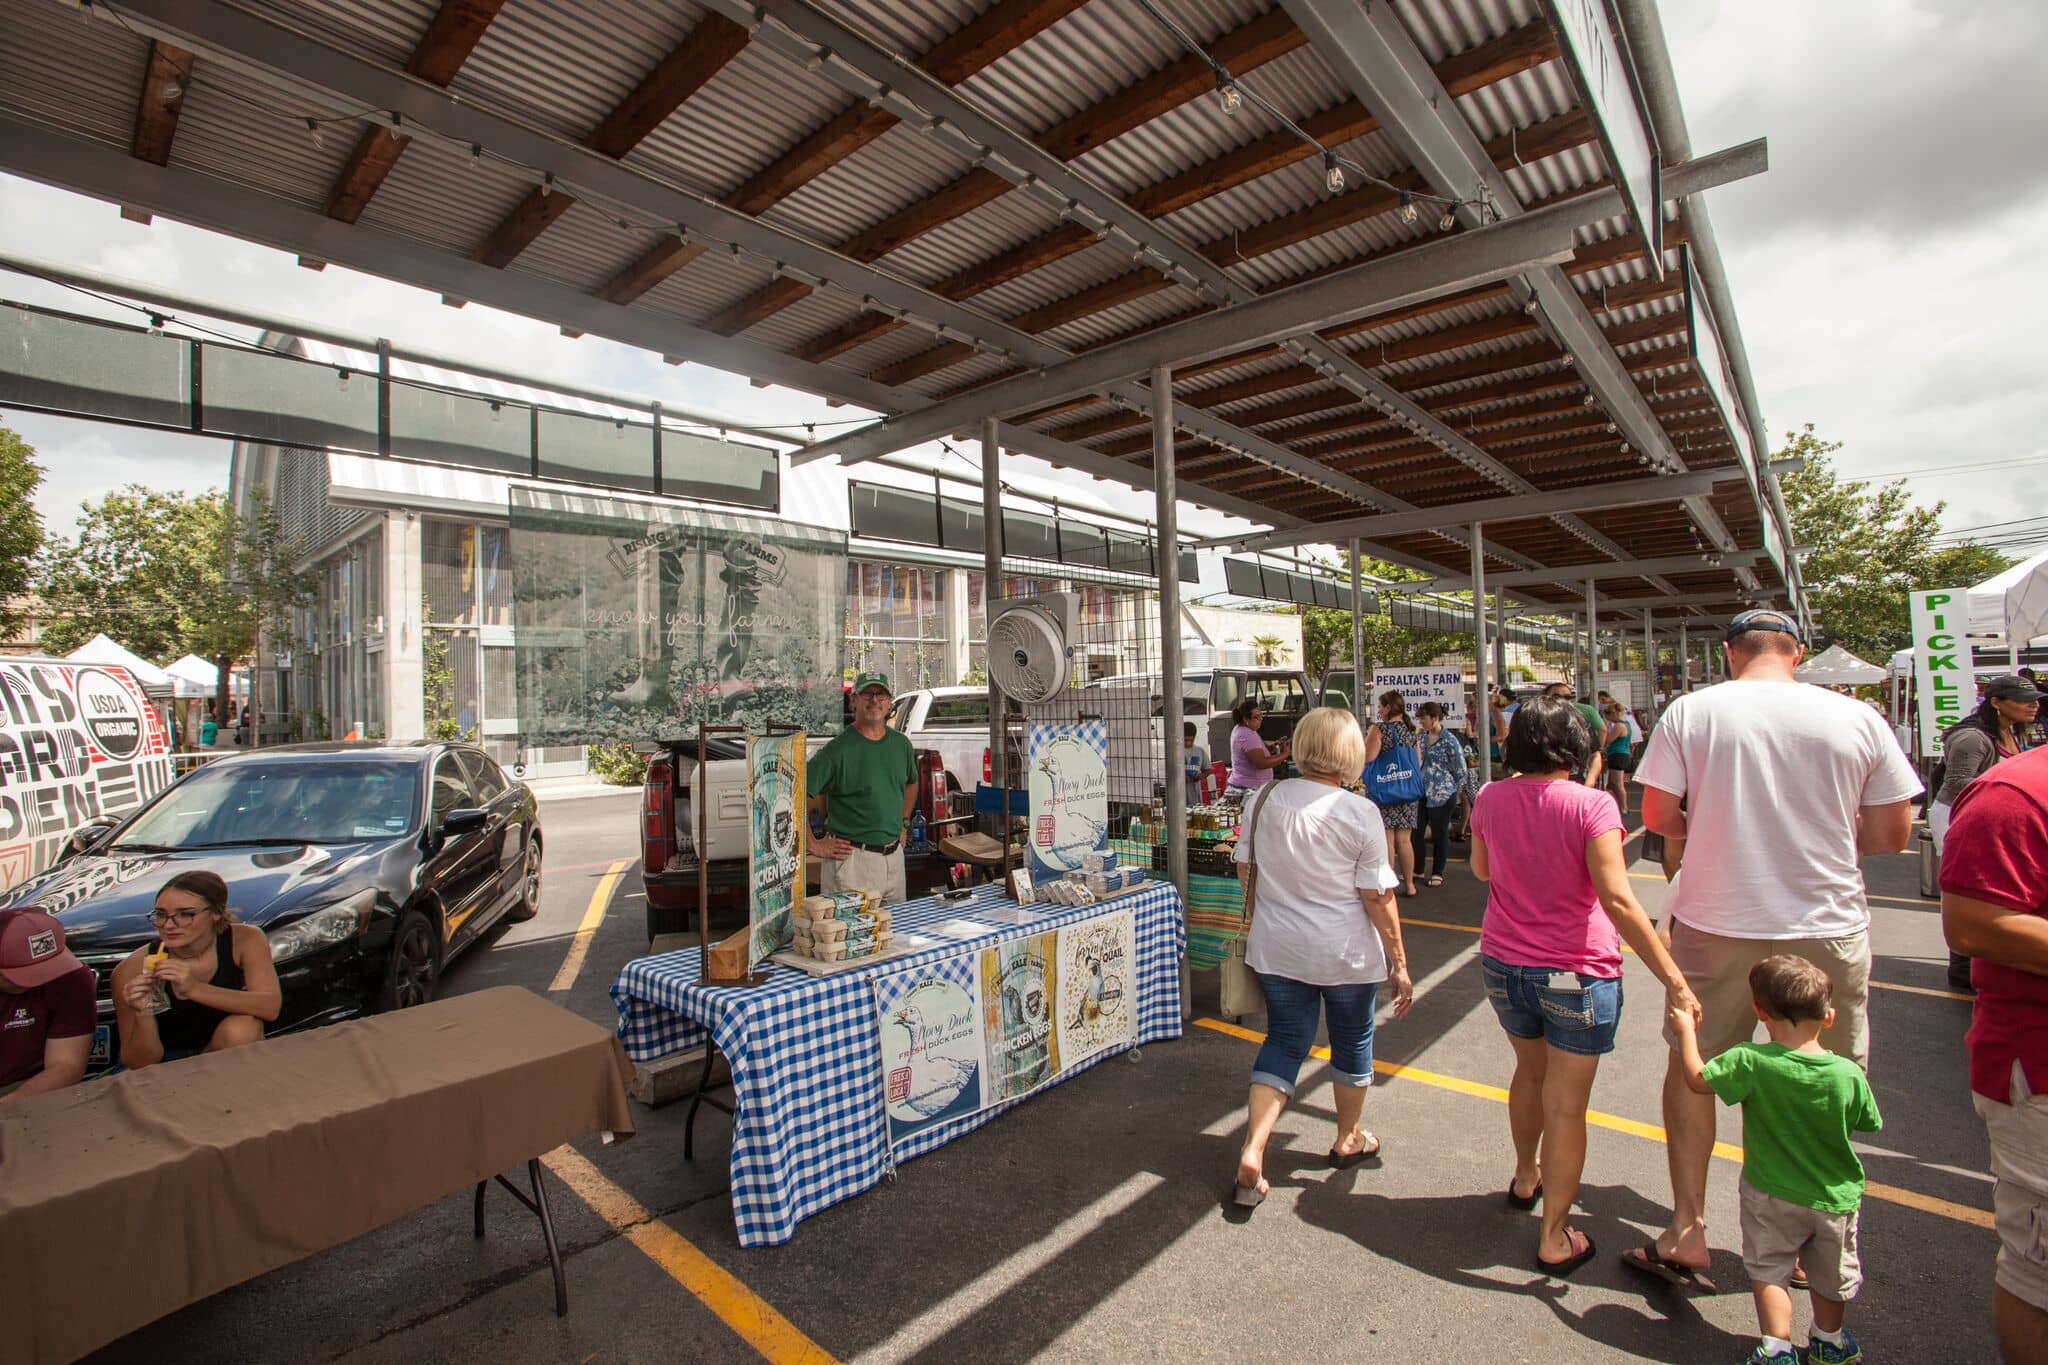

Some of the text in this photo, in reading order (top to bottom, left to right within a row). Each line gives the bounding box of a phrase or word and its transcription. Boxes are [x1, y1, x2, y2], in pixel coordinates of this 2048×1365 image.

[622, 531, 667, 555] RISING
[738, 539, 779, 565] FARMS
[666, 608, 721, 646] your
[1925, 594, 1960, 730] PICKLES
[1376, 673, 1461, 686] PERALTA'S FARM
[1434, 688, 1445, 697] Tx
[89, 694, 128, 714] USDA
[95, 721, 138, 737] ORGANIC
[1376, 768, 1413, 781] Academy
[1067, 794, 1085, 803] DUCK
[1087, 791, 1106, 800] EGGS
[1102, 946, 1123, 963] QUAIL
[899, 1027, 974, 1060] FRESH DUCK EGGS
[991, 1030, 1033, 1056] CHICKEN
